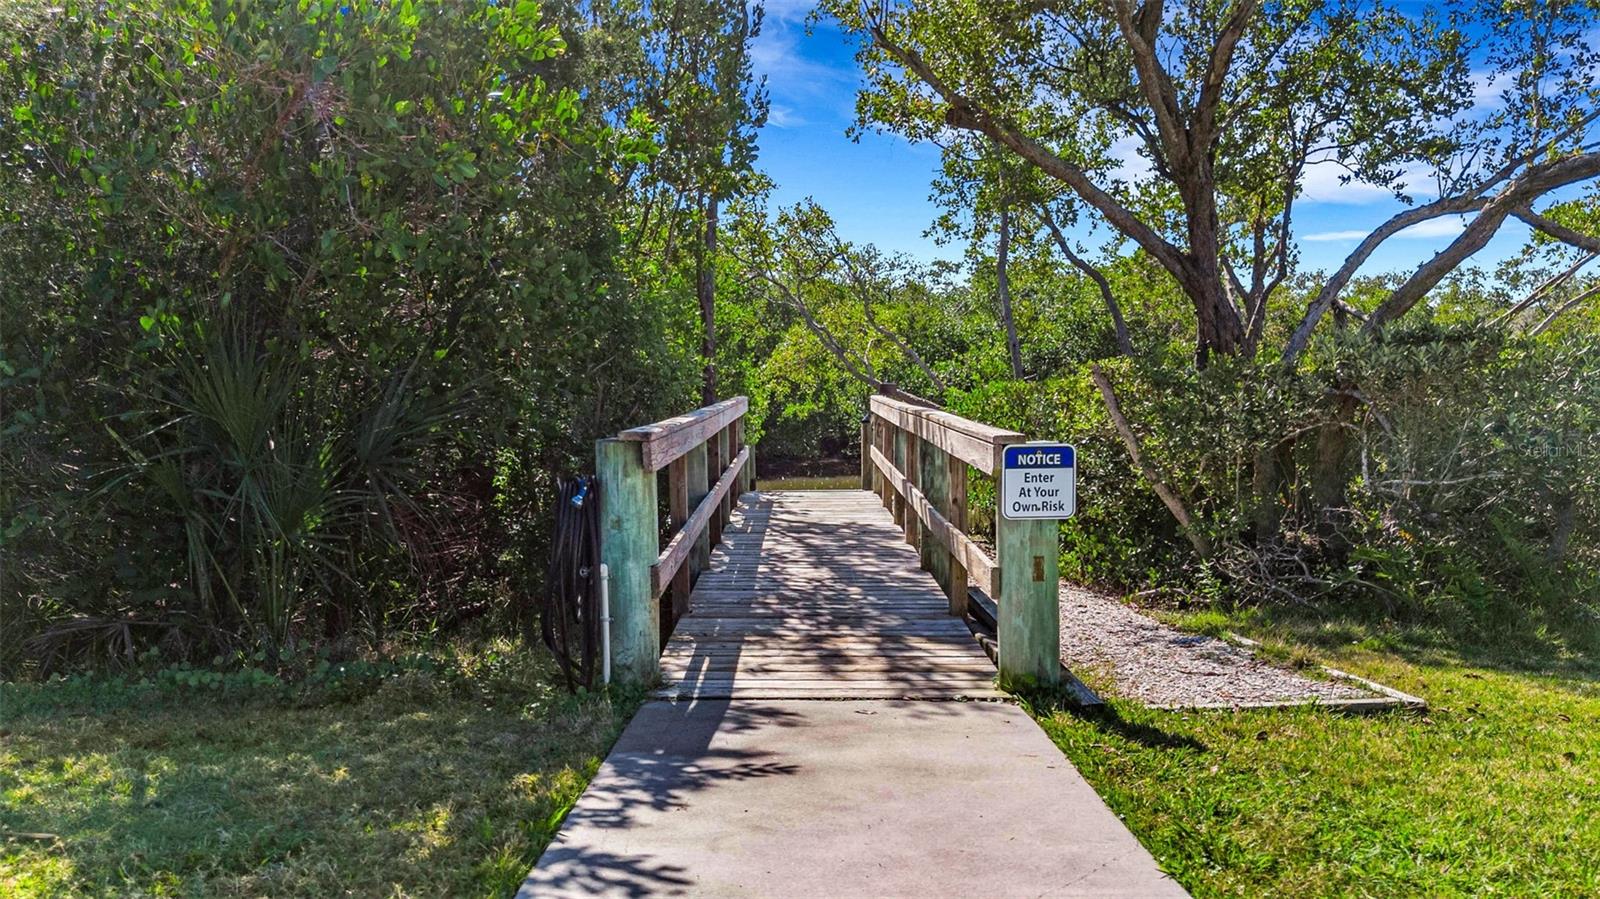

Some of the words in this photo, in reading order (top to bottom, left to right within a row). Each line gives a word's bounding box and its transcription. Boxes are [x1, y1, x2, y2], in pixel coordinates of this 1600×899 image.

[1018, 454, 1061, 465] NOTICE
[1024, 472, 1055, 483] Enter
[1018, 487, 1031, 498] At
[1034, 487, 1060, 498] Your
[1012, 501, 1038, 512] Own
[1041, 500, 1065, 511] Risk
